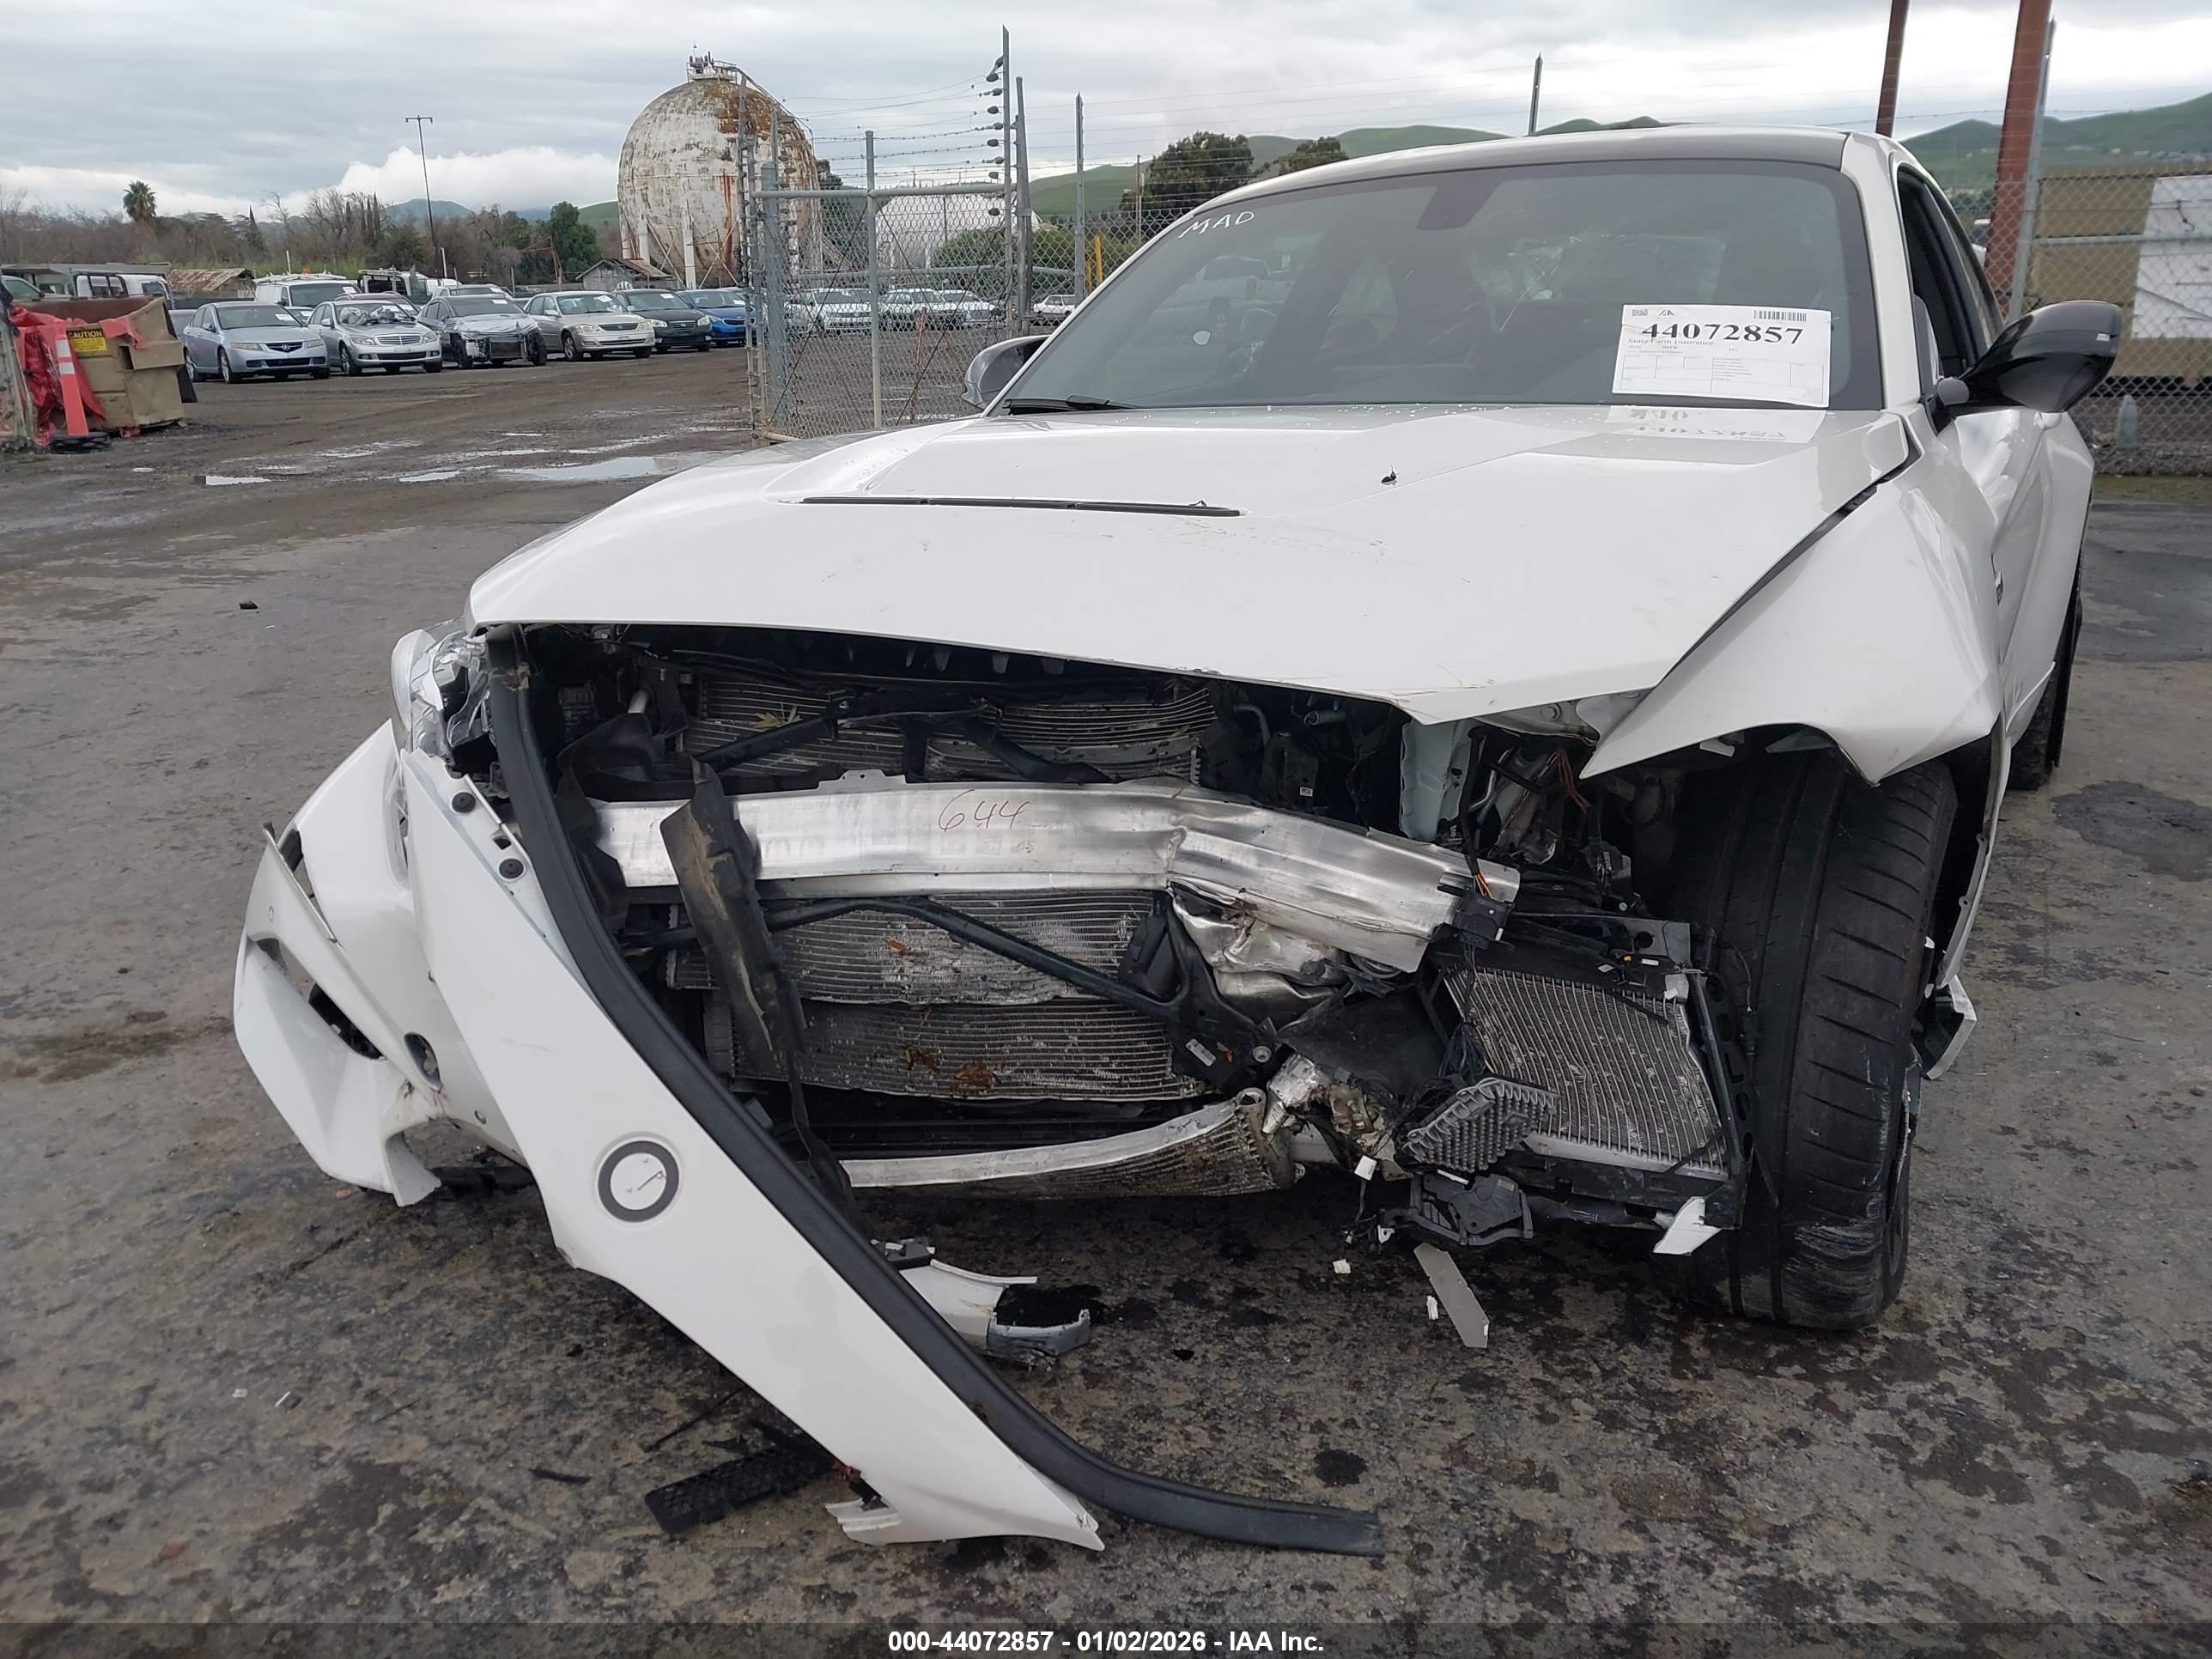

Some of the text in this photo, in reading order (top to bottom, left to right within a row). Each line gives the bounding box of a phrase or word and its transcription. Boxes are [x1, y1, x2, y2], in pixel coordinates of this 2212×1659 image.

[1177, 211, 1255, 239] MAD
[68, 330, 103, 338] CAUTION
[1642, 323, 1804, 344] 44072857
[939, 789, 1030, 833] 644
